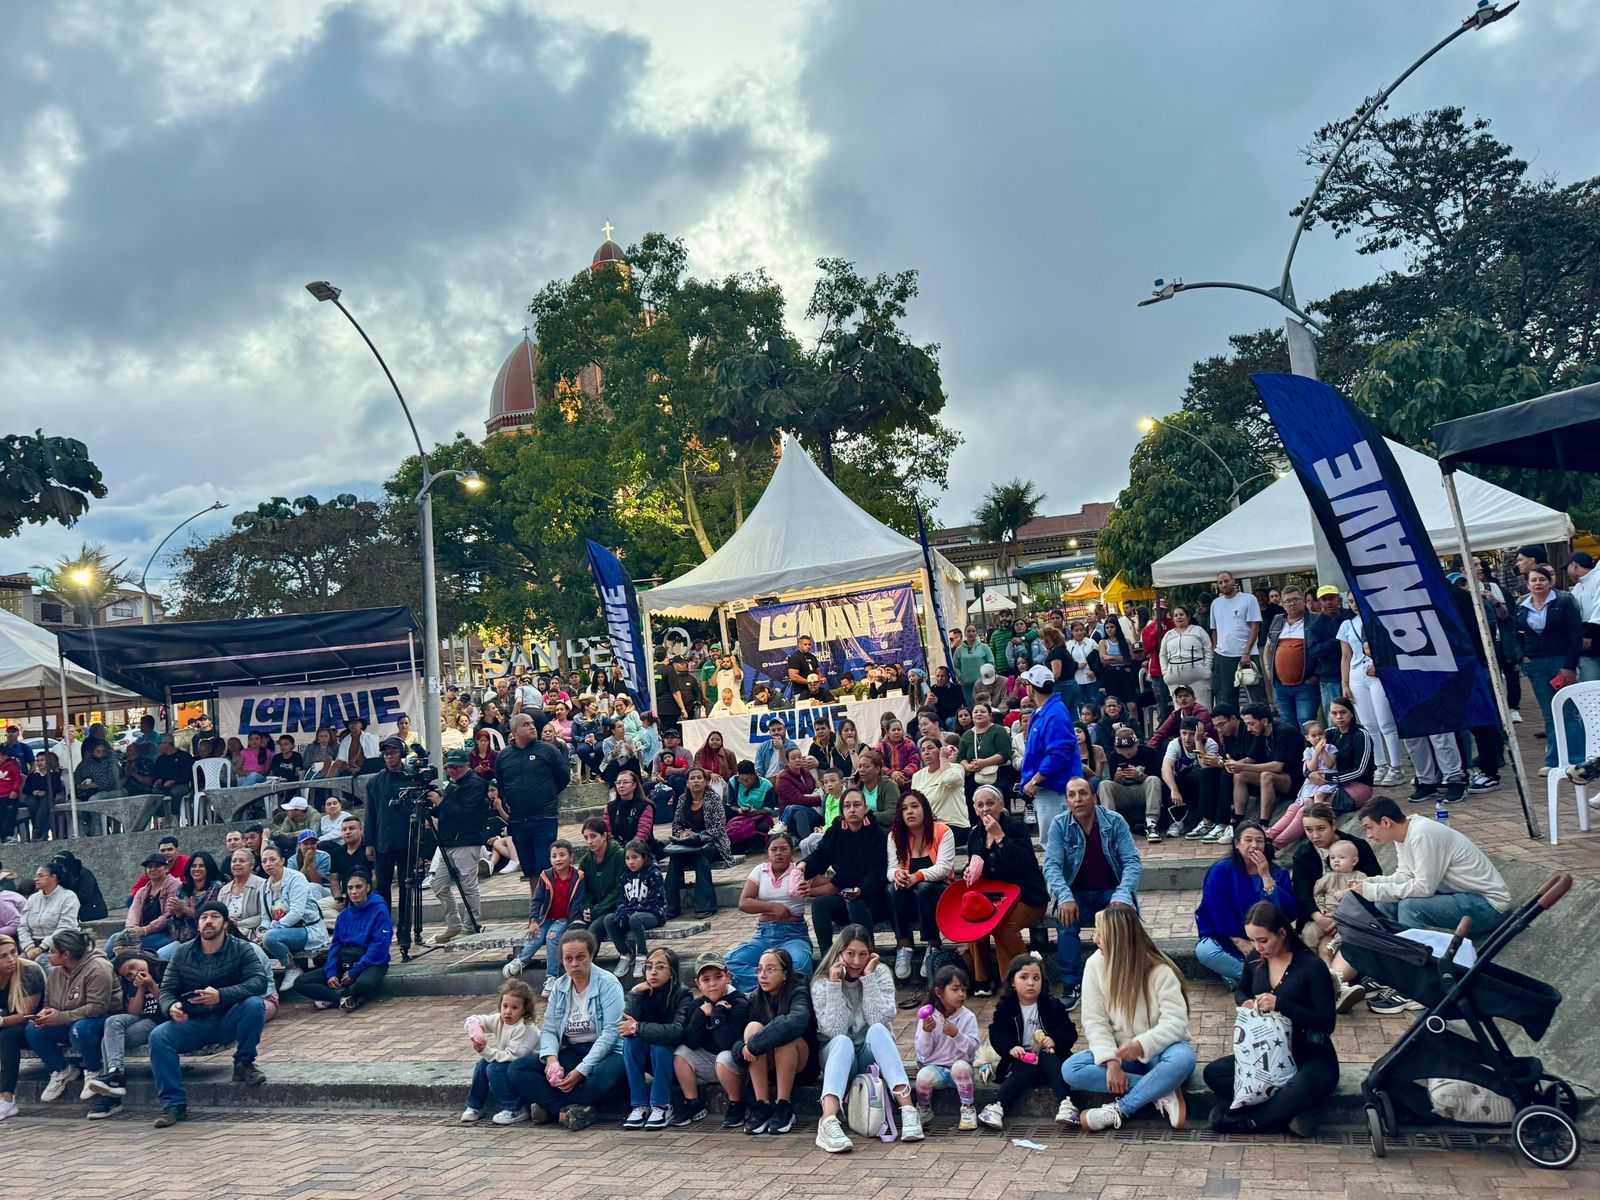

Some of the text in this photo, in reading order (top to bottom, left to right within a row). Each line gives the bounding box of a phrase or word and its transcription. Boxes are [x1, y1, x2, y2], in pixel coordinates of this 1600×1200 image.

[482, 640, 559, 679] SAN
[624, 878, 649, 902] GAP
[566, 1019, 591, 1028] herry
